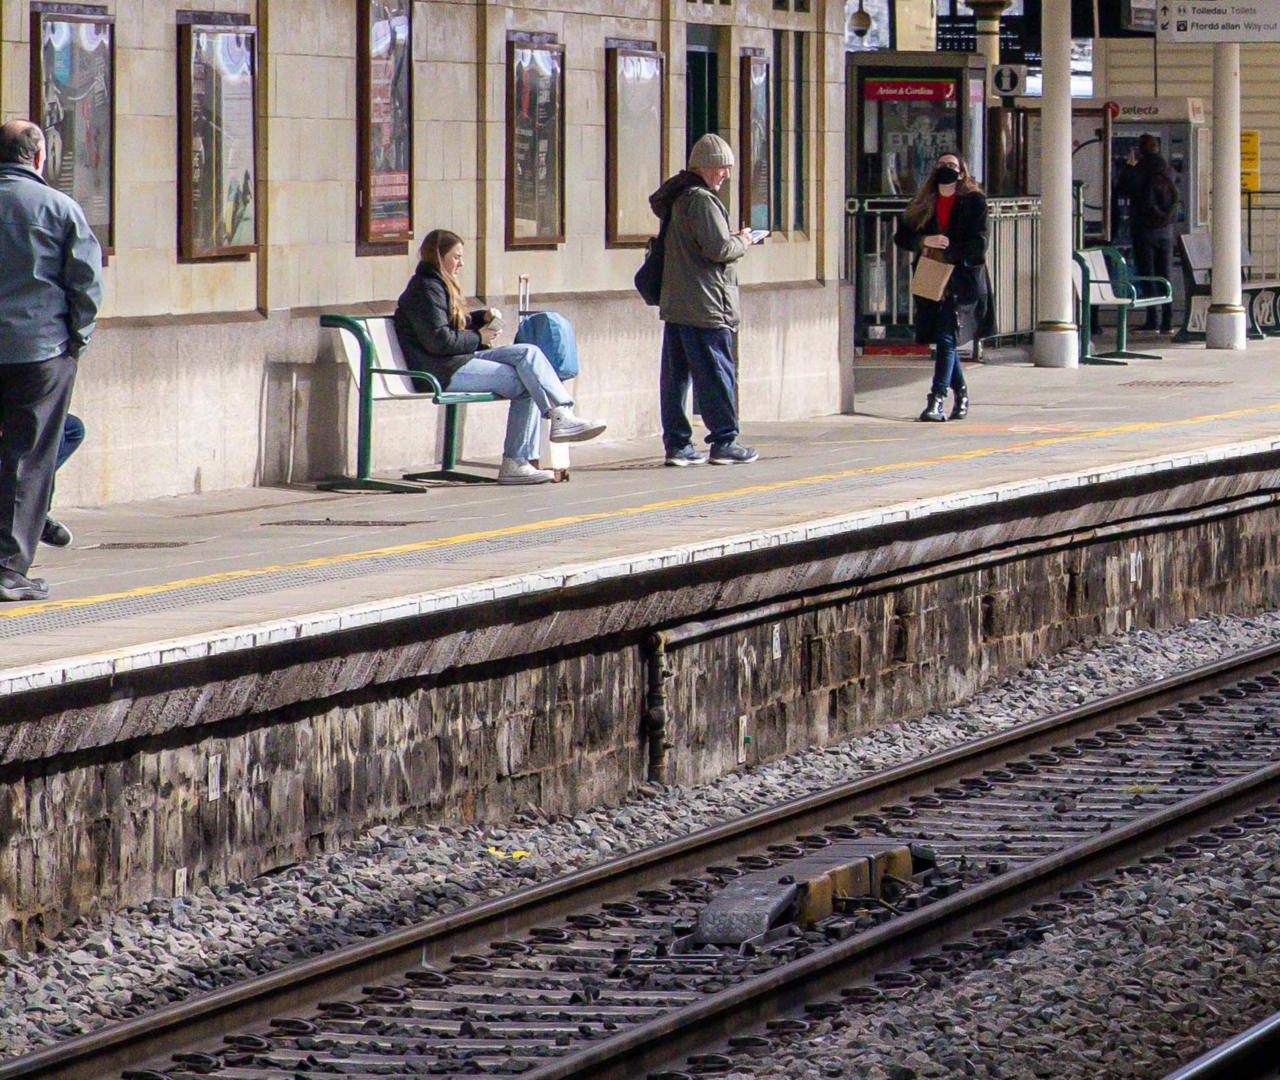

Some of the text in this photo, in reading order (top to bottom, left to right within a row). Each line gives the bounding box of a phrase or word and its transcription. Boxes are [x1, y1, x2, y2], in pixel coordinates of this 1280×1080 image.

[1231, 6, 1257, 15] Toilets
[1220, 22, 1241, 30] allan
[1243, 23, 1262, 32] Way
[1121, 103, 1159, 115] selecta
